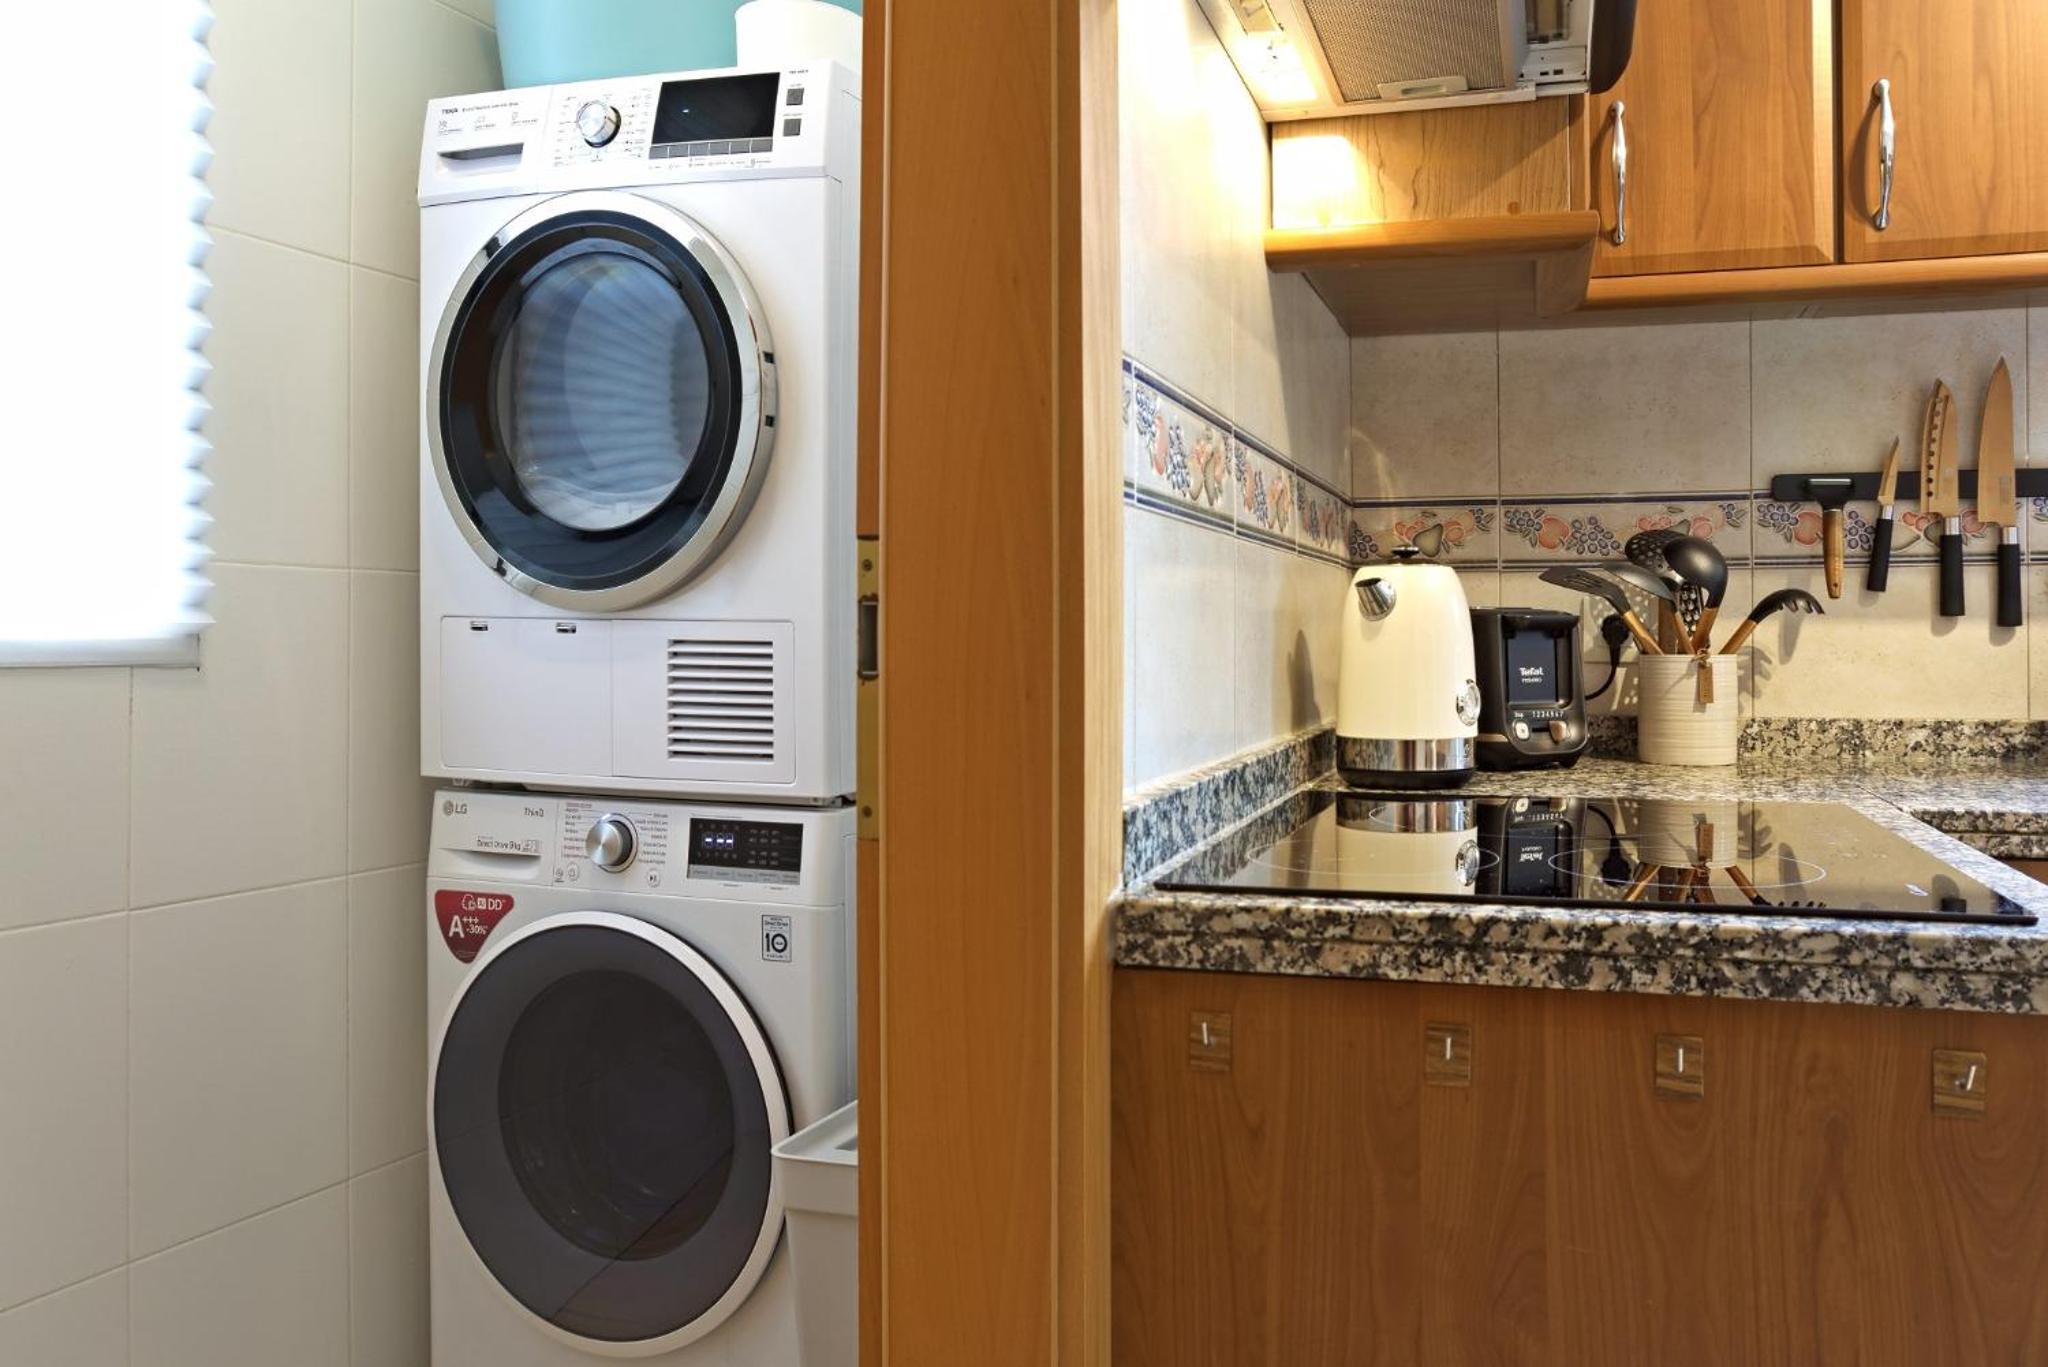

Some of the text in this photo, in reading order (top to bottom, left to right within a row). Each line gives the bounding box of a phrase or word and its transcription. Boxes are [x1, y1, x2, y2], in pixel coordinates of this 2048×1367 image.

[1519, 666, 1544, 676] Tefal
[455, 803, 467, 814] LG
[765, 932, 788, 953] 10
